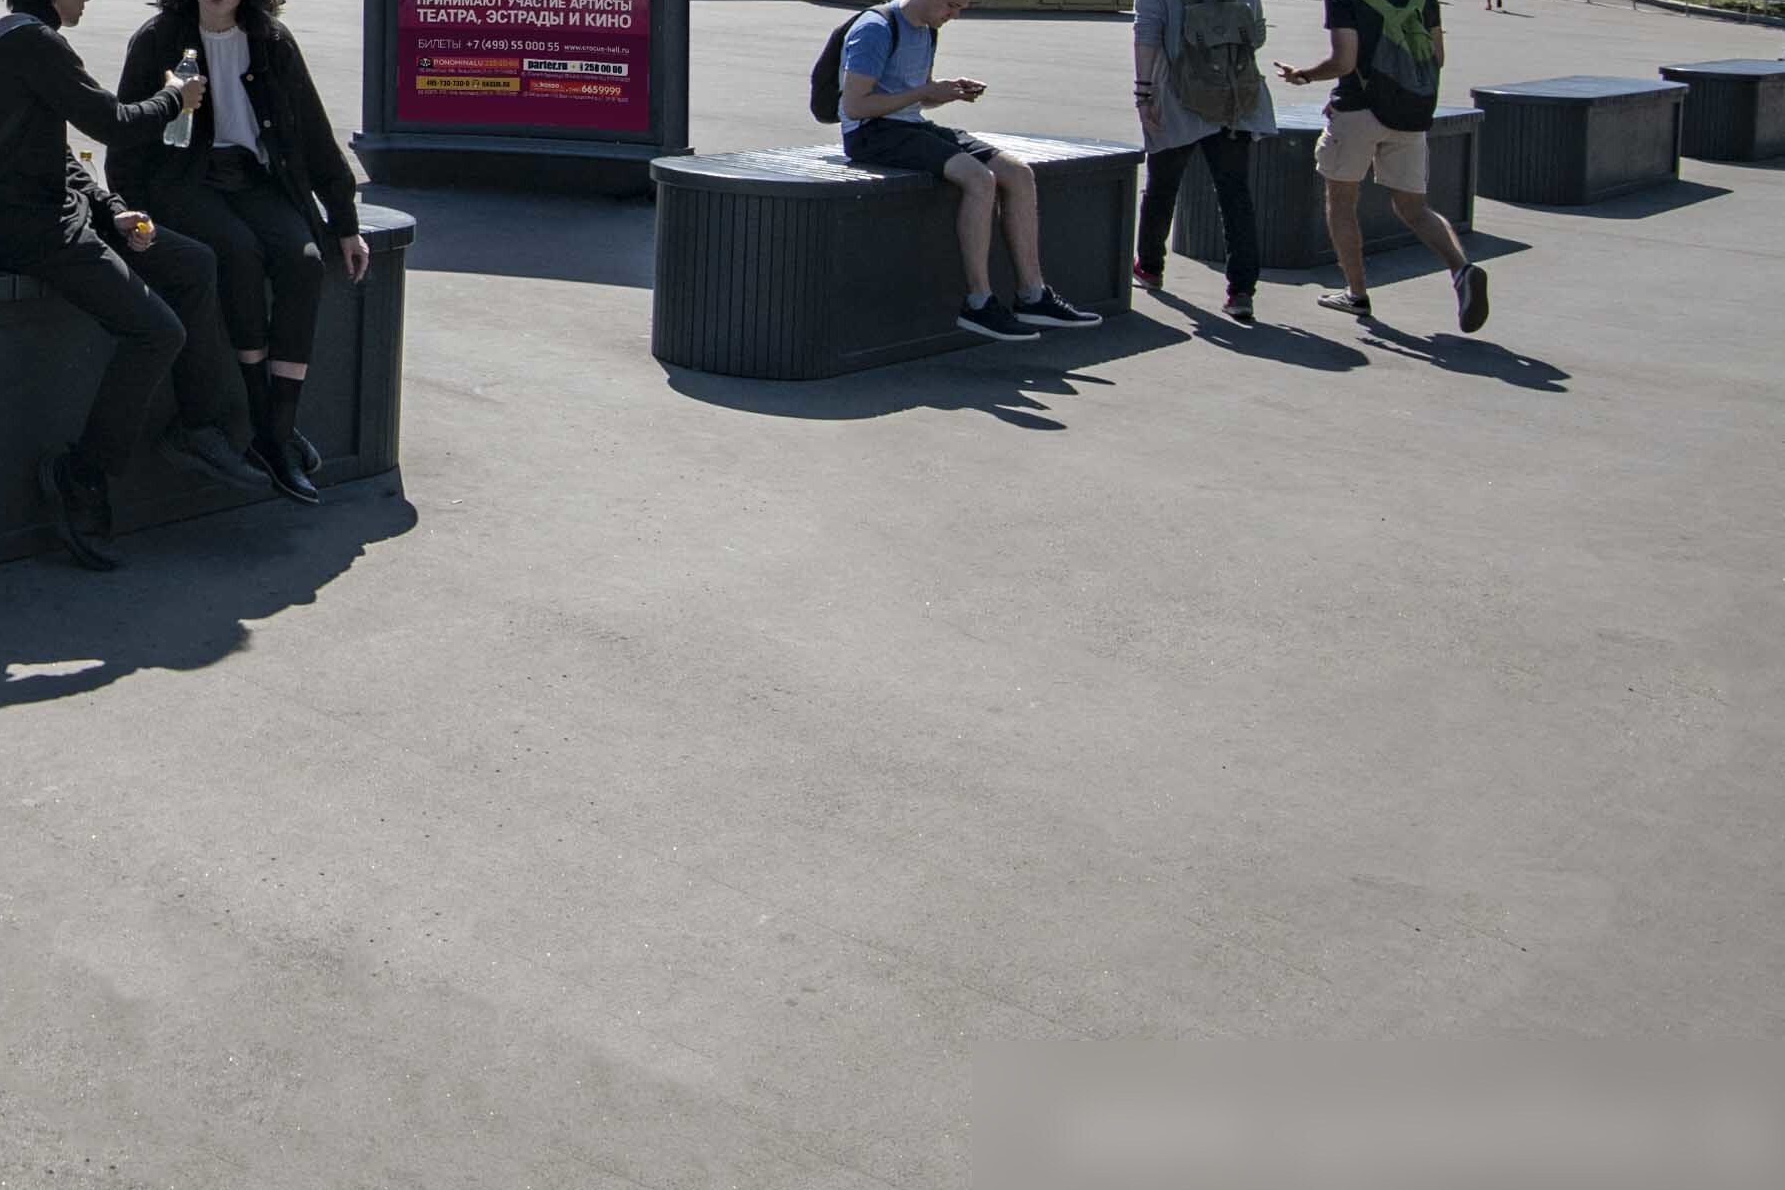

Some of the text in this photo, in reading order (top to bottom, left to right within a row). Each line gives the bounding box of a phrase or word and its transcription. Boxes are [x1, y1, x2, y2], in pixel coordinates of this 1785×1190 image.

[417, 9, 632, 29] ТЕАТРА, ЭСТРАДЫ И КИНО
[417, 39, 462, 49] БИЛЕТЫ
[466, 39, 480, 49] +7
[481, 39, 509, 50] (499)
[510, 40, 524, 50] 55
[524, 41, 546, 51] 000
[547, 42, 560, 52] 55
